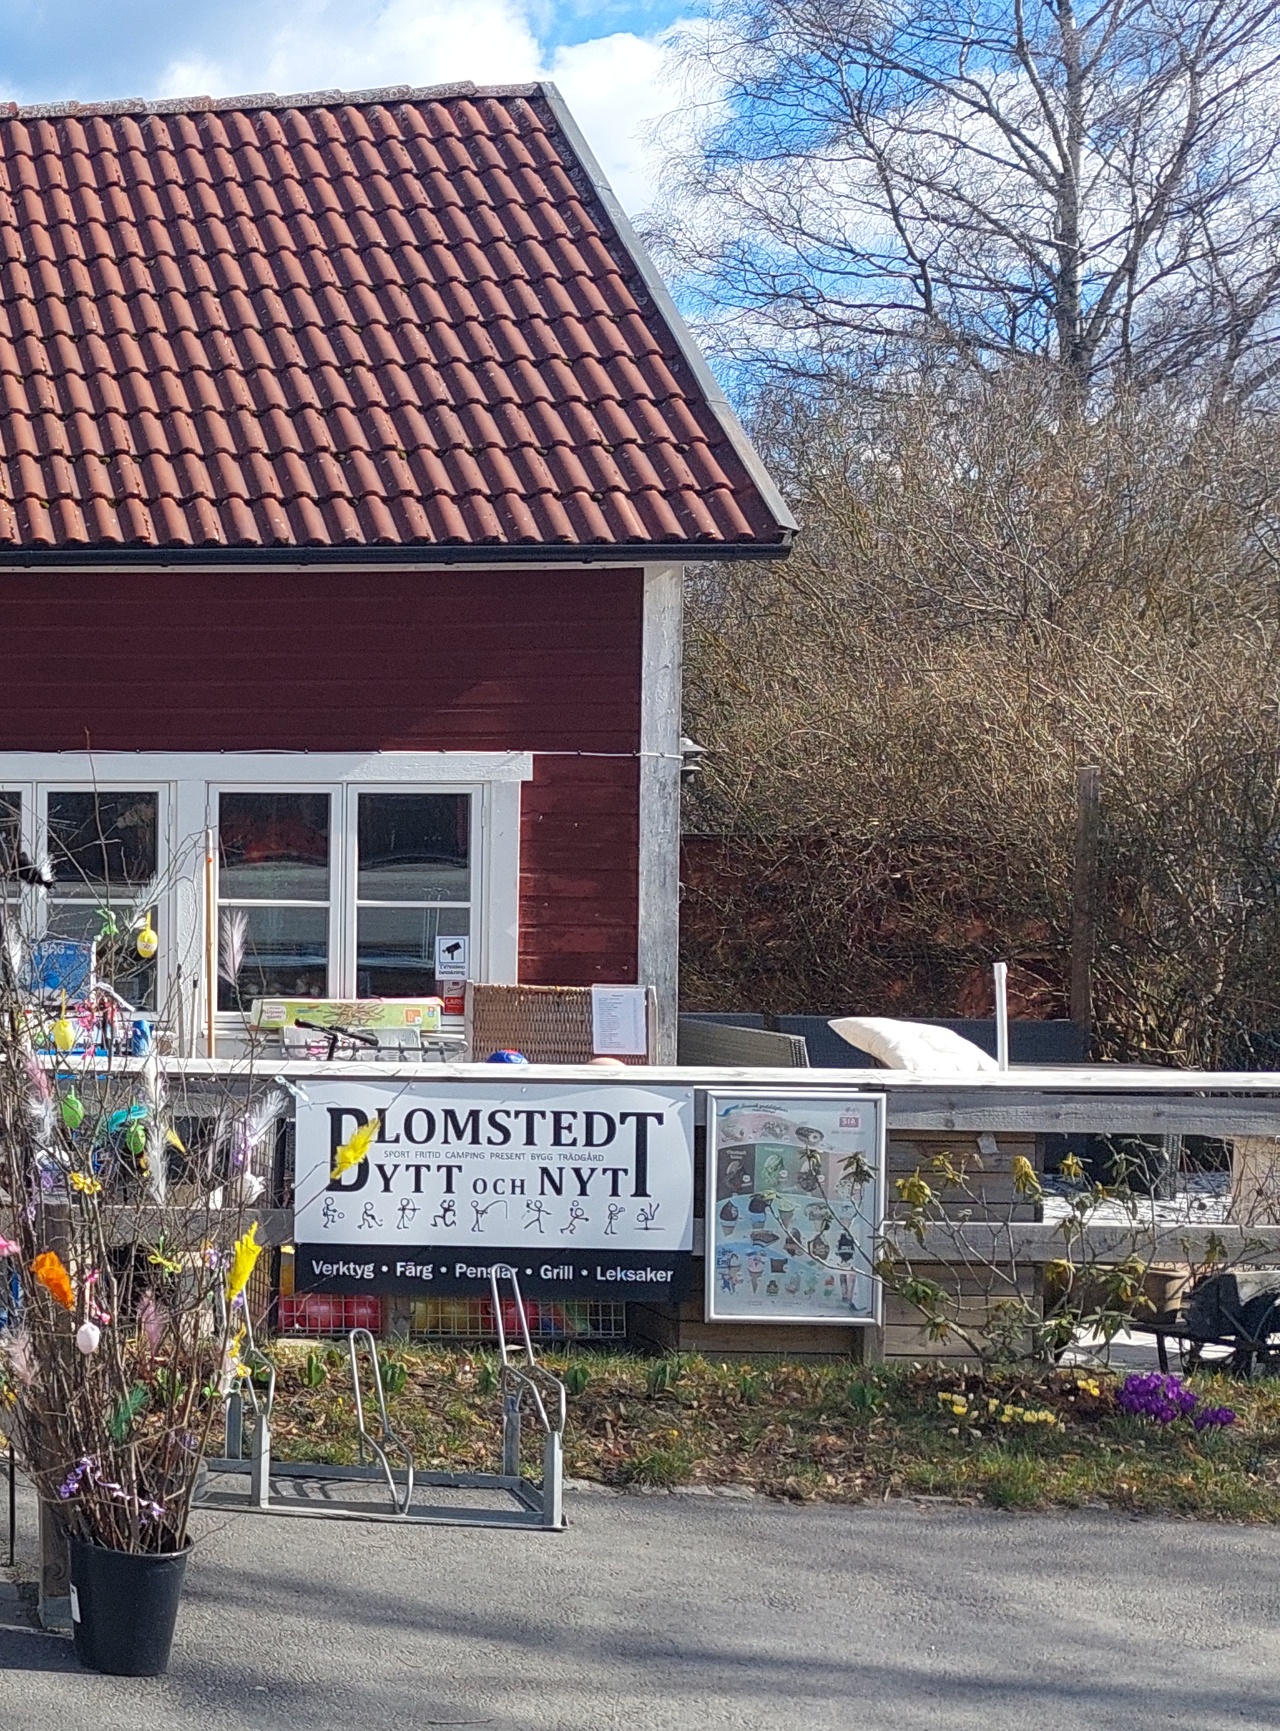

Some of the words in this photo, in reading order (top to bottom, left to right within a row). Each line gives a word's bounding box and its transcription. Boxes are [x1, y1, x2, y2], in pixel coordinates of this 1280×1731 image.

[383, 1150, 411, 1159] SPORT
[414, 1150, 442, 1159] FRITID
[444, 1151, 486, 1160] CAMPING
[489, 1151, 527, 1161] PRESENT
[530, 1152, 554, 1161] BYGG
[557, 1150, 605, 1162] TRÄDGÅRD
[472, 1177, 526, 1196] OCH
[311, 1259, 375, 1280] Verktyg
[396, 1261, 434, 1280] Färg
[540, 1264, 573, 1280] Grill
[596, 1266, 674, 1283] Leksaker
